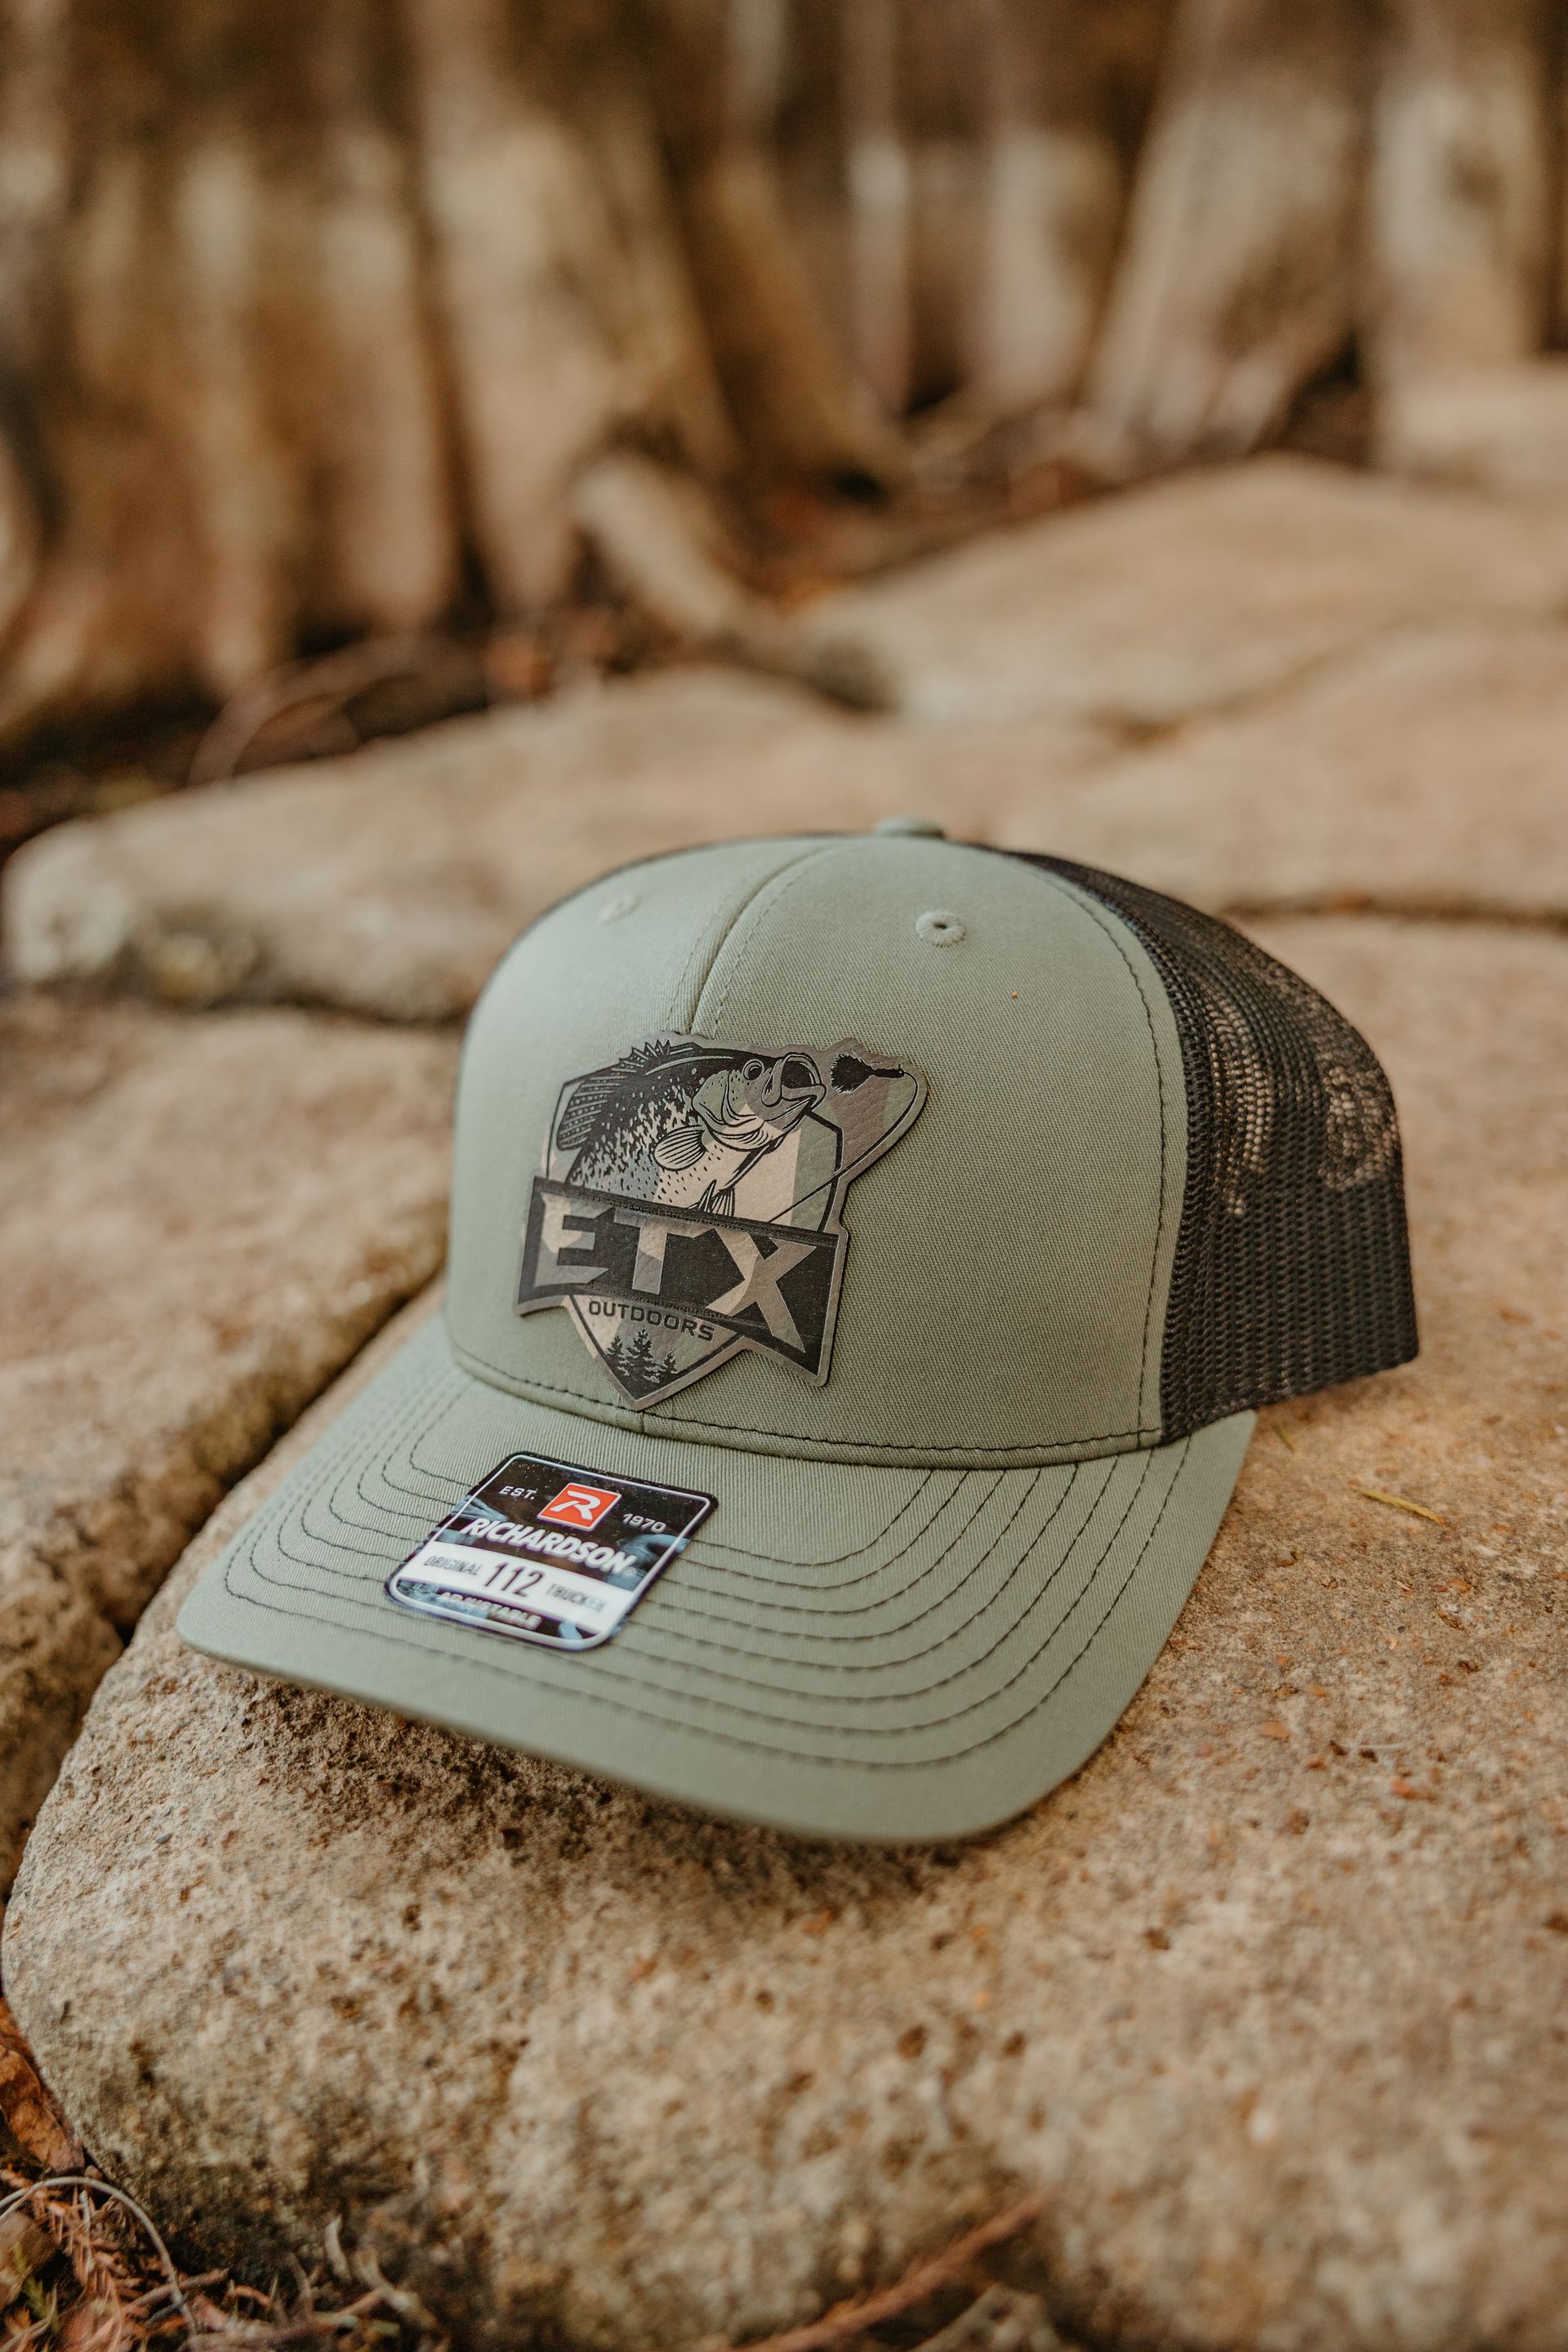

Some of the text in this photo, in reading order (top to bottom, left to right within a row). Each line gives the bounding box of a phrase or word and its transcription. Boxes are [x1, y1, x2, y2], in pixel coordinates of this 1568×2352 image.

[535, 1192, 817, 1353] ETX
[588, 1300, 715, 1342] OUTDOORS
[499, 1486, 539, 1500] EST.
[622, 1512, 666, 1534] 1970
[423, 1555, 608, 1613] ORIGINAL 112 TRUCKER
